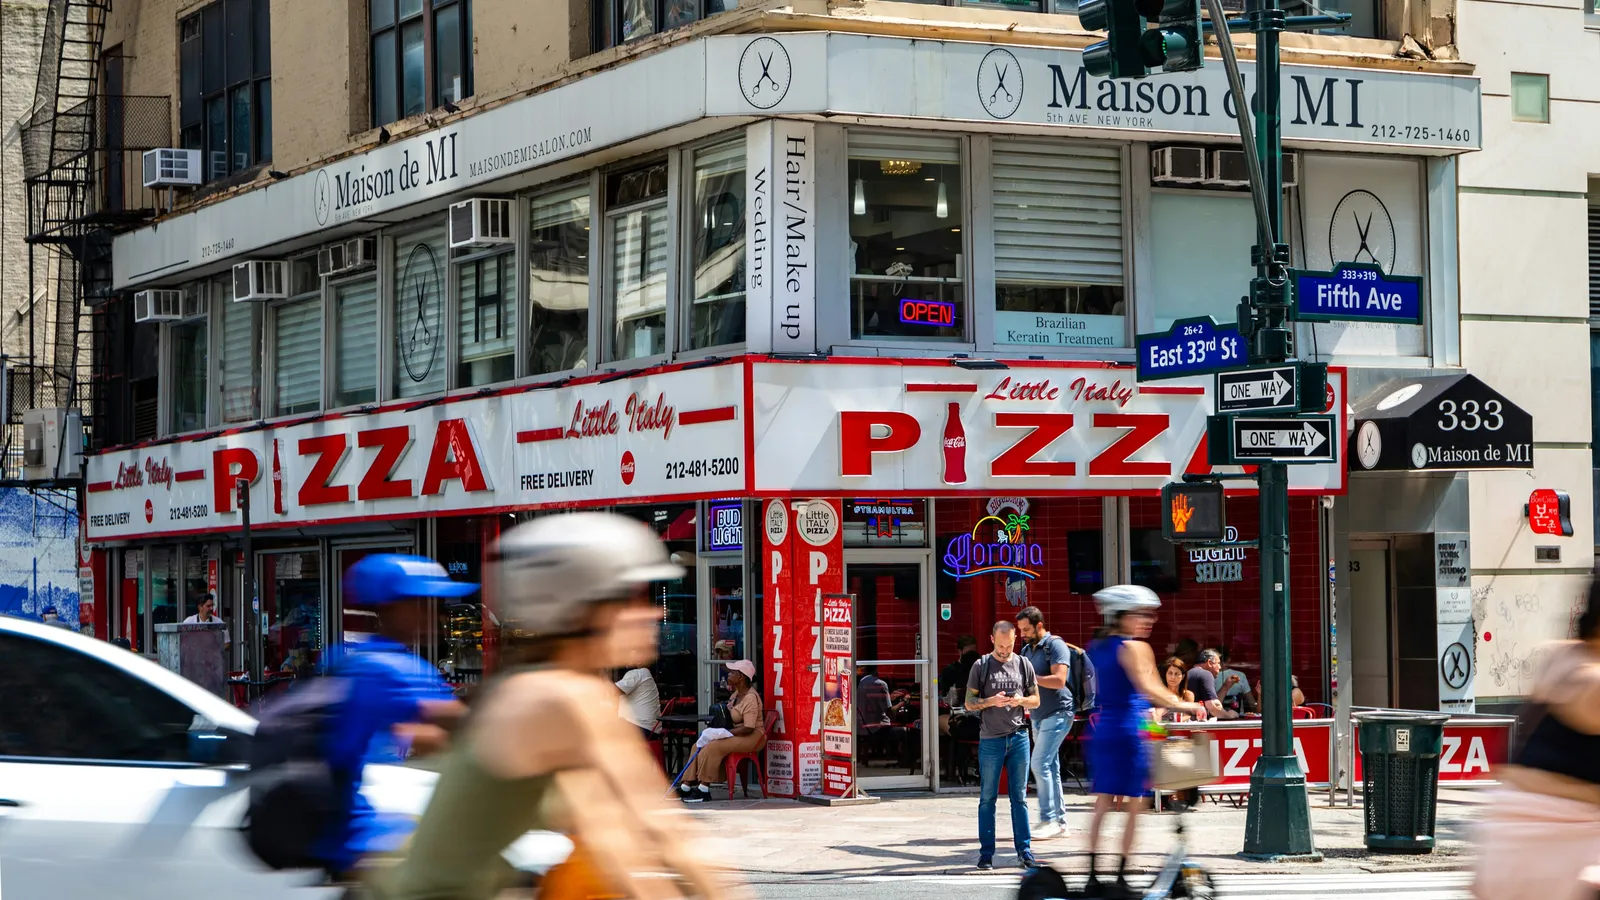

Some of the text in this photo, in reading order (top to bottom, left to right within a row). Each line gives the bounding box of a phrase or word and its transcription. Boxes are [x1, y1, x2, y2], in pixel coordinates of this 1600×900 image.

[1047, 64, 1208, 117] Maison
[1291, 76, 1364, 128] MI
[1047, 113, 1154, 128] 5th AVE NEW YORK
[1371, 124, 1470, 143] 212-725-1460
[469, 126, 592, 178] MAISONDEMISALON.COM
[335, 132, 458, 211] Maison de MI
[751, 167, 766, 290] Wedding
[781, 135, 807, 340] Hair/Make up
[201, 237, 235, 258] 212-725-1460
[1318, 284, 1402, 311] Fifth Ave
[903, 301, 951, 324] OPEN
[1035, 316, 1086, 330] Brazilian
[1184, 326, 1193, 335] 26
[1007, 331, 1114, 346] Keratin Treatment
[1150, 336, 1238, 368] East 33rd St
[985, 376, 1133, 407] Little Italy
[1231, 380, 1284, 399] ONE WAY
[566, 391, 677, 440] Little Italy
[1437, 399, 1504, 431] 333
[1250, 431, 1317, 446] ONE WAY
[1427, 443, 1531, 463] Maison de MI
[114, 456, 173, 491] Little Italy
[666, 457, 739, 480] 212-481-5200
[521, 469, 594, 491] FREE DELIVERY
[90, 512, 130, 527] FREE DELIVERY
[170, 504, 208, 520] 212-481-5200
[717, 509, 741, 528] BUD
[770, 510, 783, 519] Little
[806, 510, 829, 520] Little
[853, 505, 914, 515] #TEAMULTRA
[943, 533, 1044, 582] Corona
[1439, 550, 1460, 558] YORK
[1439, 558, 1454, 566] ART
[1196, 562, 1243, 583] SELTZER
[1439, 566, 1466, 575] STUDIO
[824, 608, 851, 623] PIZZA
